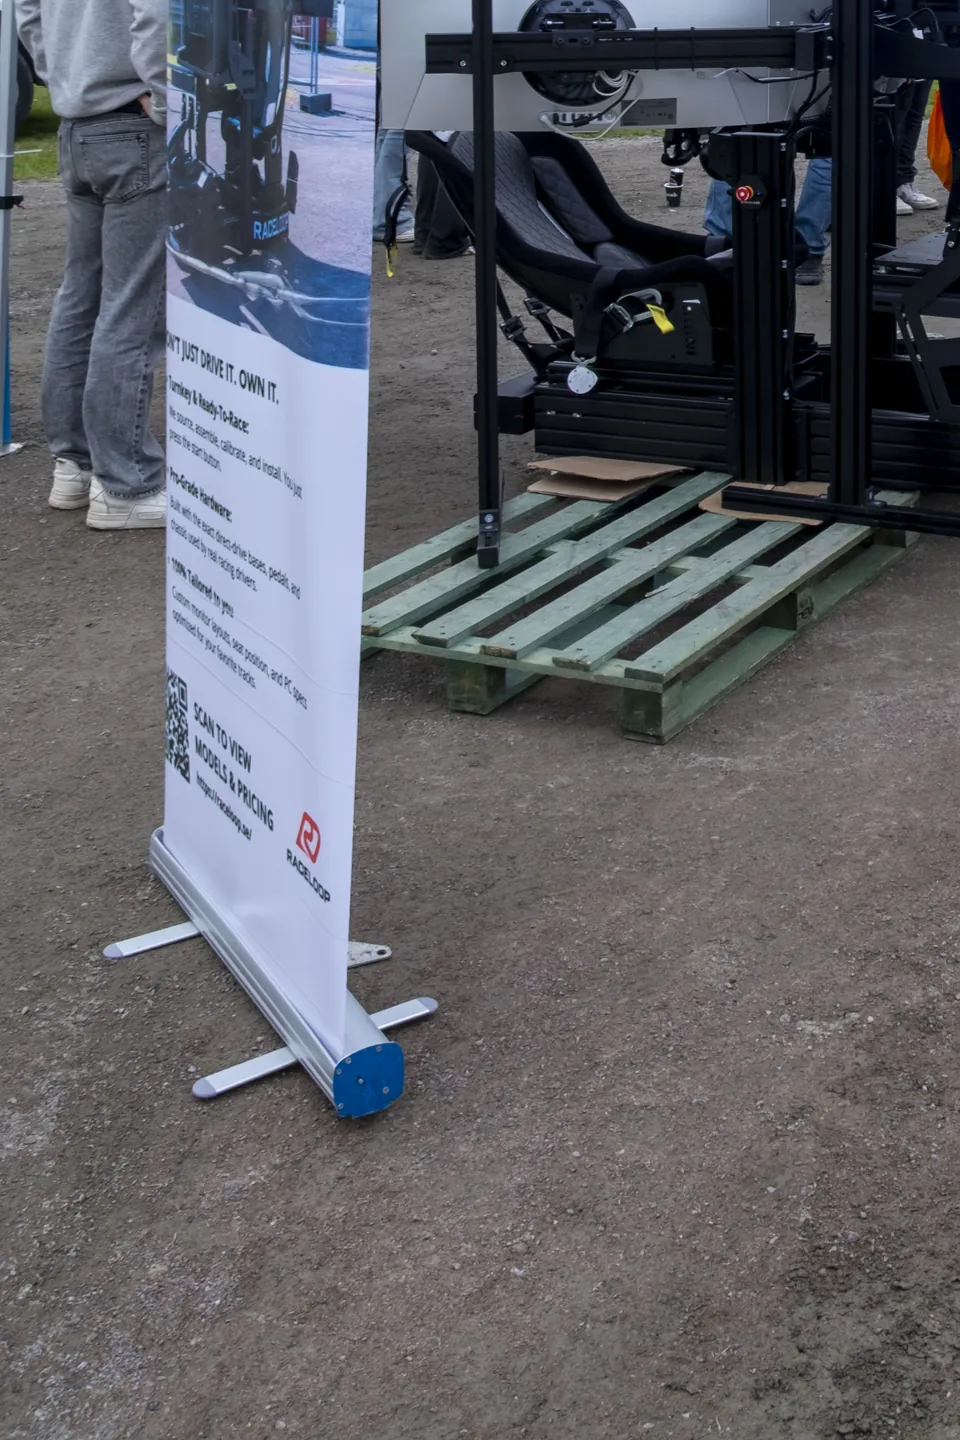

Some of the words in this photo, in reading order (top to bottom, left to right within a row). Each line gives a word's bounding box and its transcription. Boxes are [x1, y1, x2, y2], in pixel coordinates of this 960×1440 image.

[181, 340, 200, 364] JUST
[201, 349, 224, 379] DRIVE
[226, 362, 237, 386] IT.
[239, 369, 265, 398] OWN
[267, 381, 279, 405] IT.
[169, 375, 192, 405] Turnkey
[198, 392, 249, 435] Ready-To-Race:
[248, 454, 261, 471] and
[290, 582, 301, 601] and
[270, 668, 283, 687] and
[193, 702, 215, 738] SCAN
[216, 723, 228, 750] TO
[229, 735, 252, 773] VIEW
[194, 735, 228, 784] MODELS
[229, 771, 236, 794] &
[238, 778, 274, 832] PRICING
[196, 771, 252, 841] https://raceloop.se/
[286, 848, 331, 903] RACELOOP
